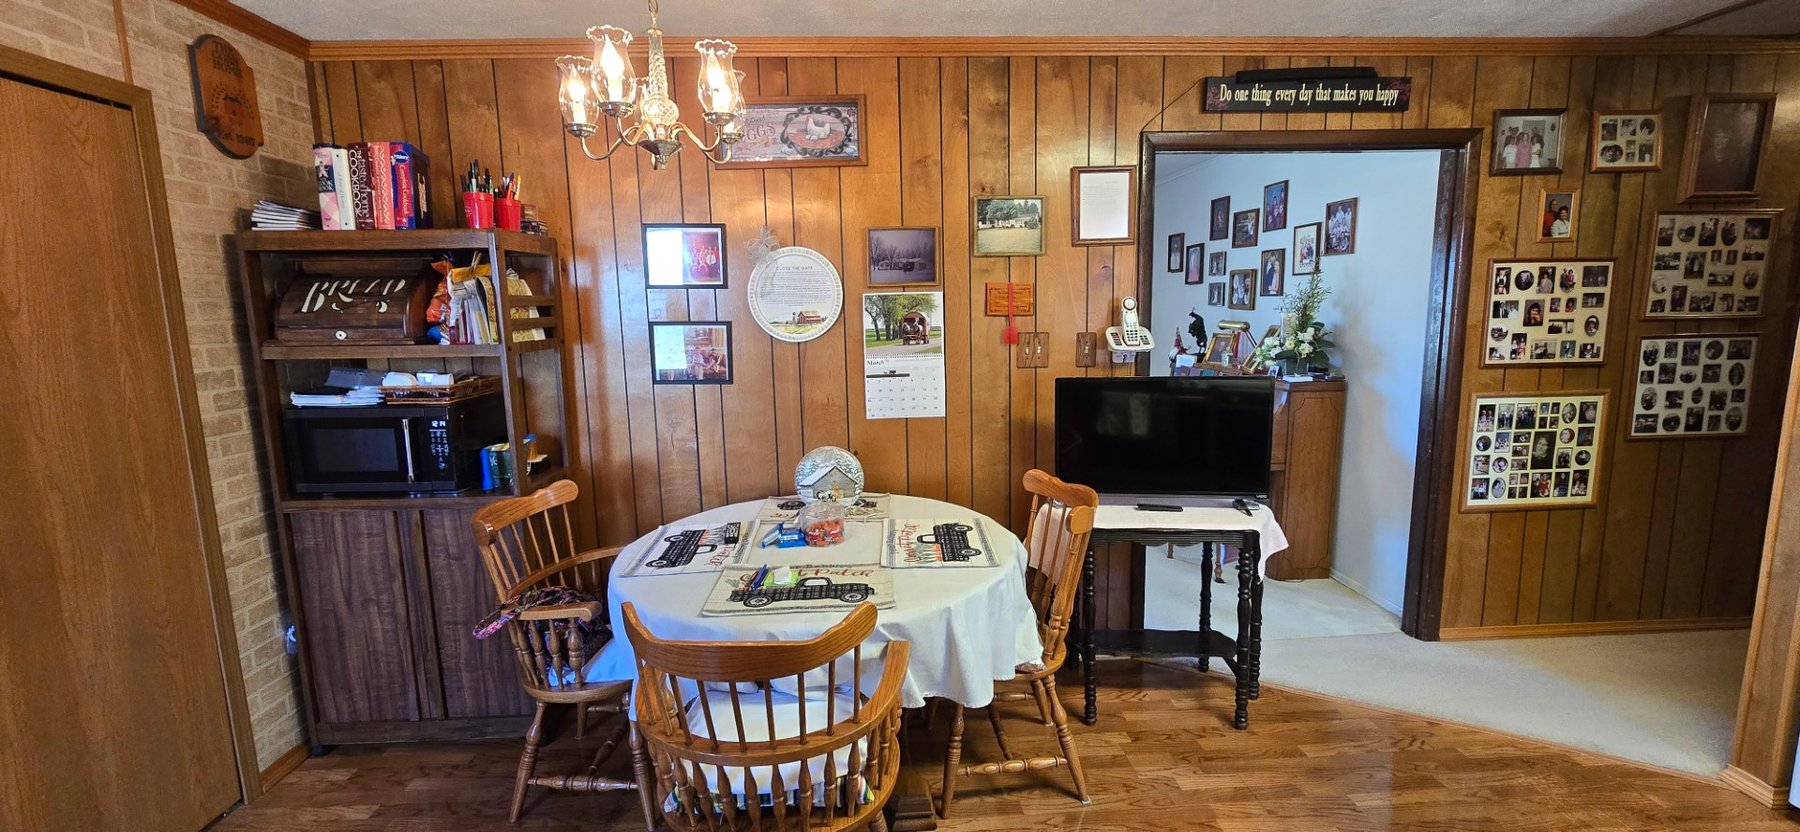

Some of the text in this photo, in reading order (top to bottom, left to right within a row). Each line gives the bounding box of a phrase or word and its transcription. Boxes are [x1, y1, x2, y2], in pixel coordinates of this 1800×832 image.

[1220, 83, 1399, 106] Do one thing every day that makes you happy
[746, 124, 776, 141] GGS
[349, 149, 362, 217] COOKBOOK
[358, 159, 368, 184] taste
[361, 190, 370, 217] home
[301, 279, 405, 313] BREAD
[808, 568, 874, 578] Patch
